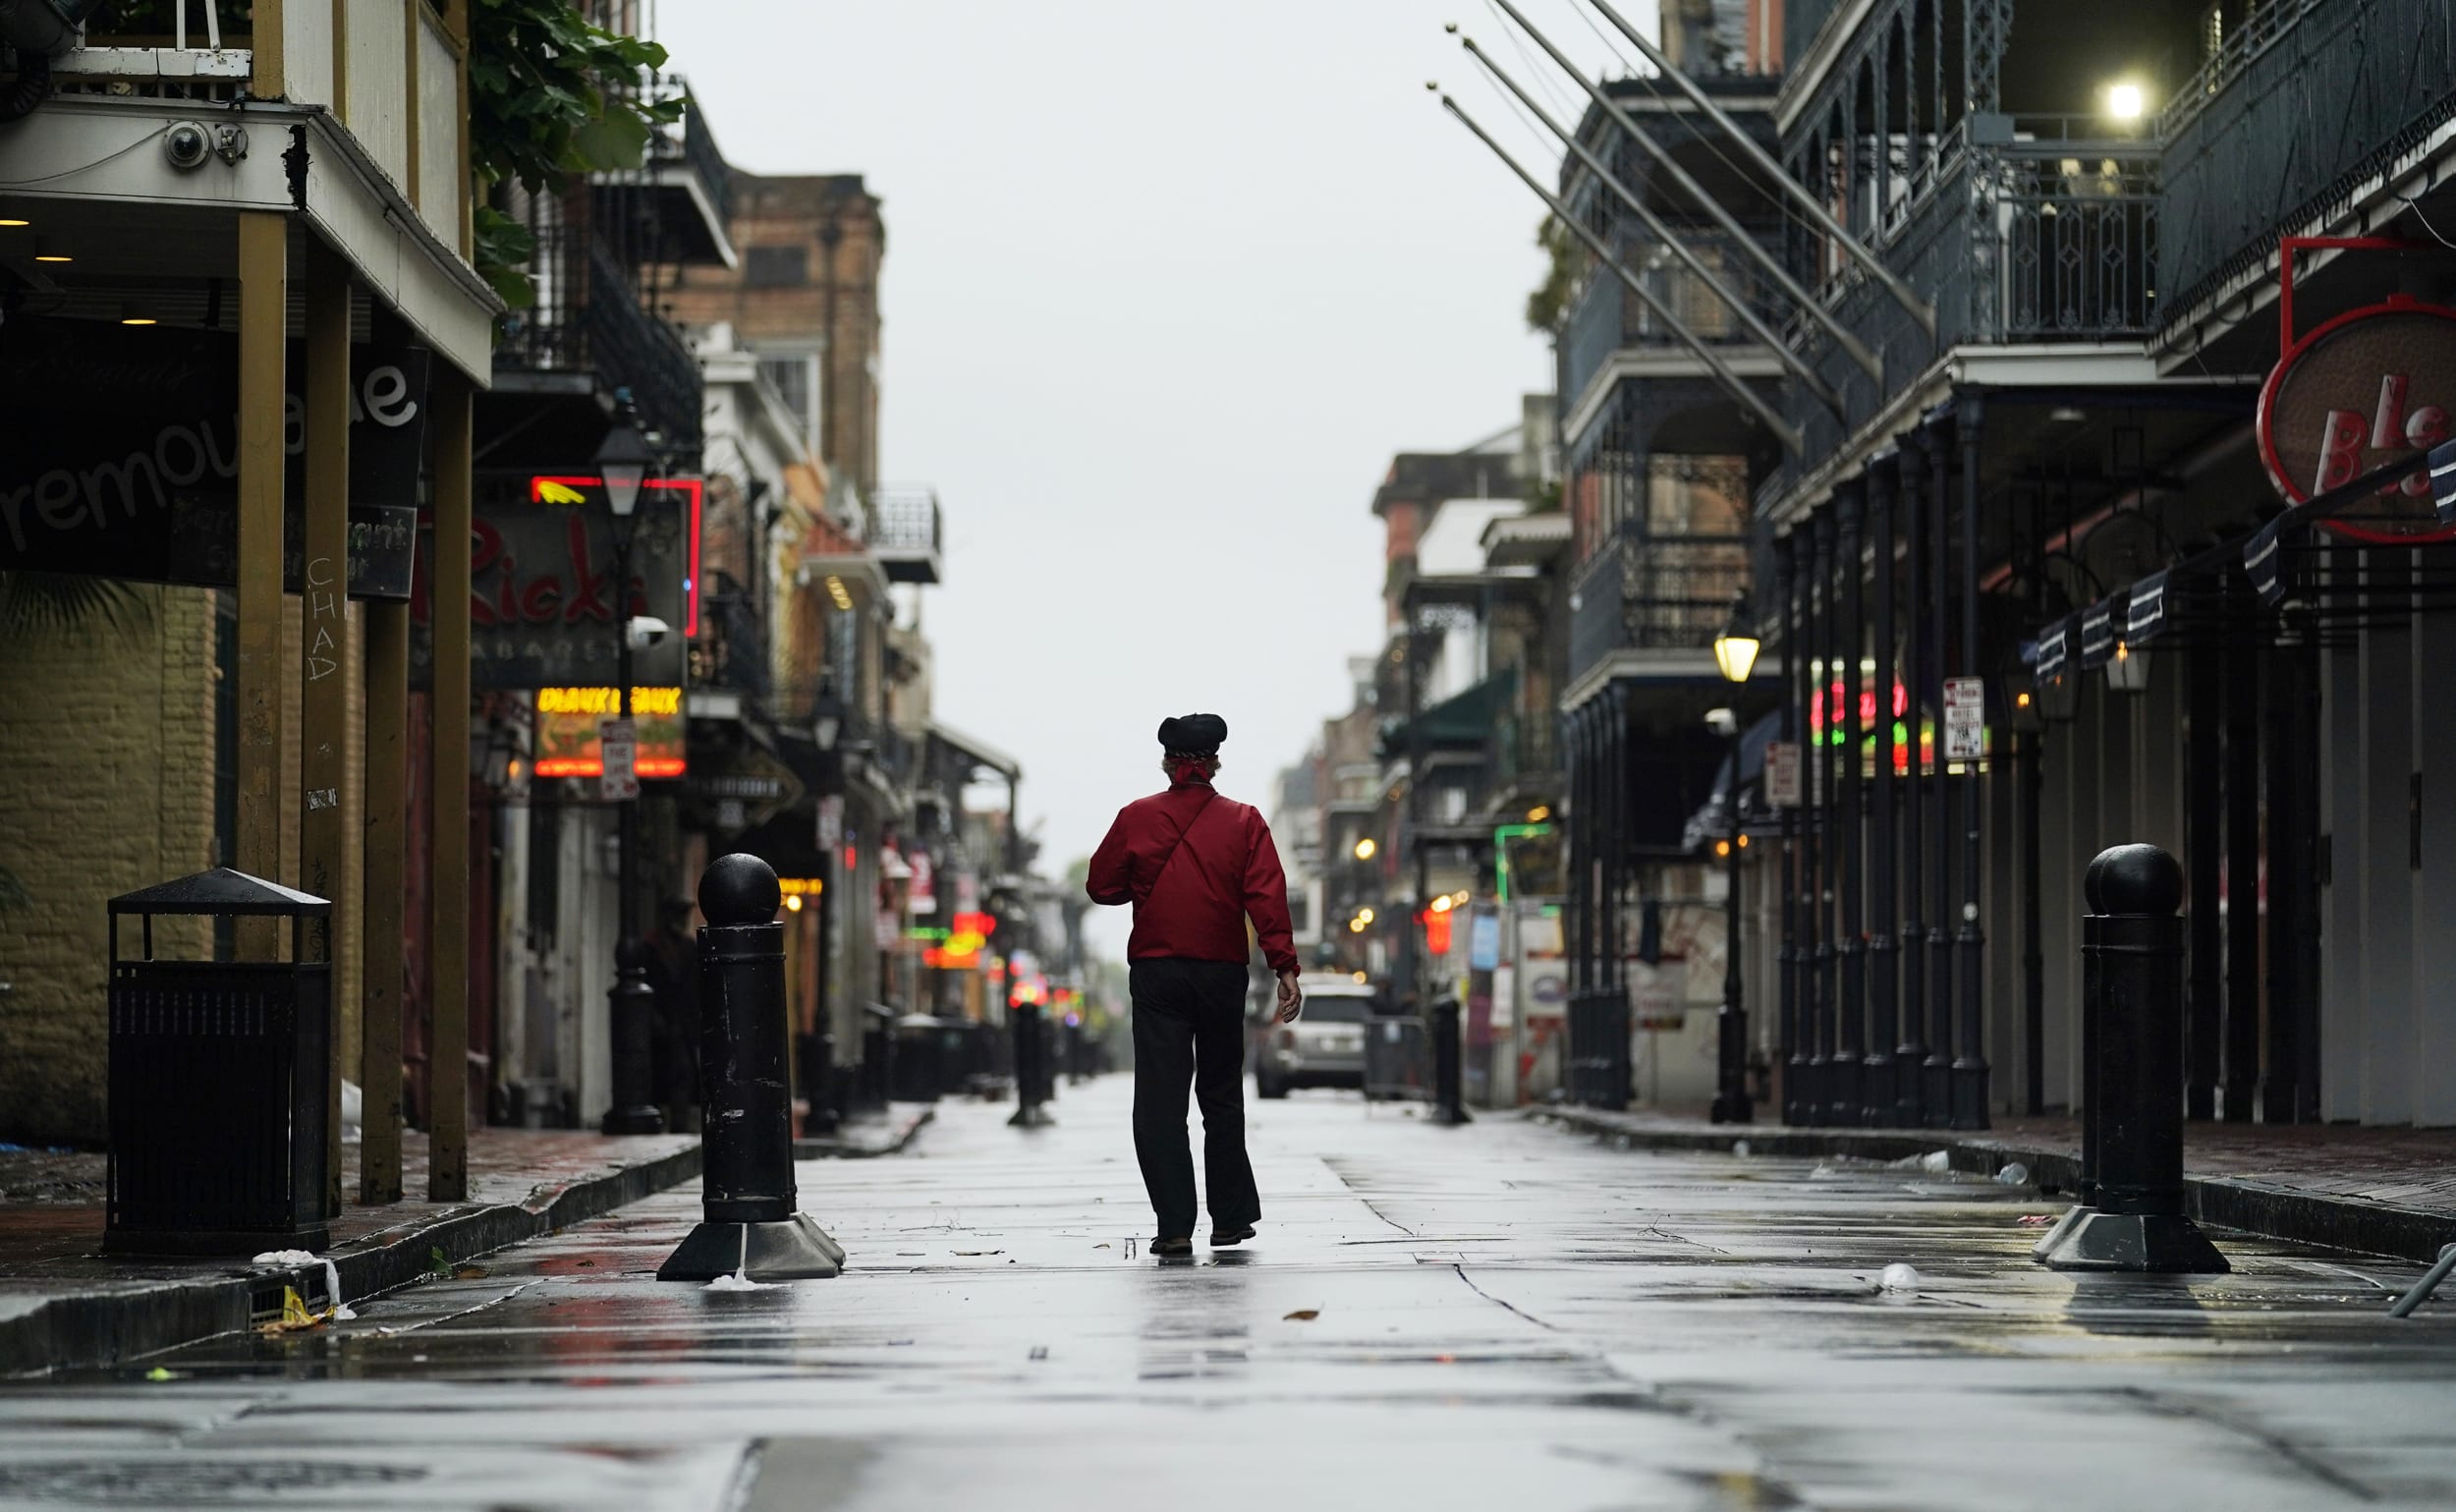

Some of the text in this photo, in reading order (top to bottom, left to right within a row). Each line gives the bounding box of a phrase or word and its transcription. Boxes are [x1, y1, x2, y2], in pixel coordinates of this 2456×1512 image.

[0, 364, 419, 553] remouae
[307, 557, 337, 680] CHAD
[471, 639, 620, 662] ABARET
